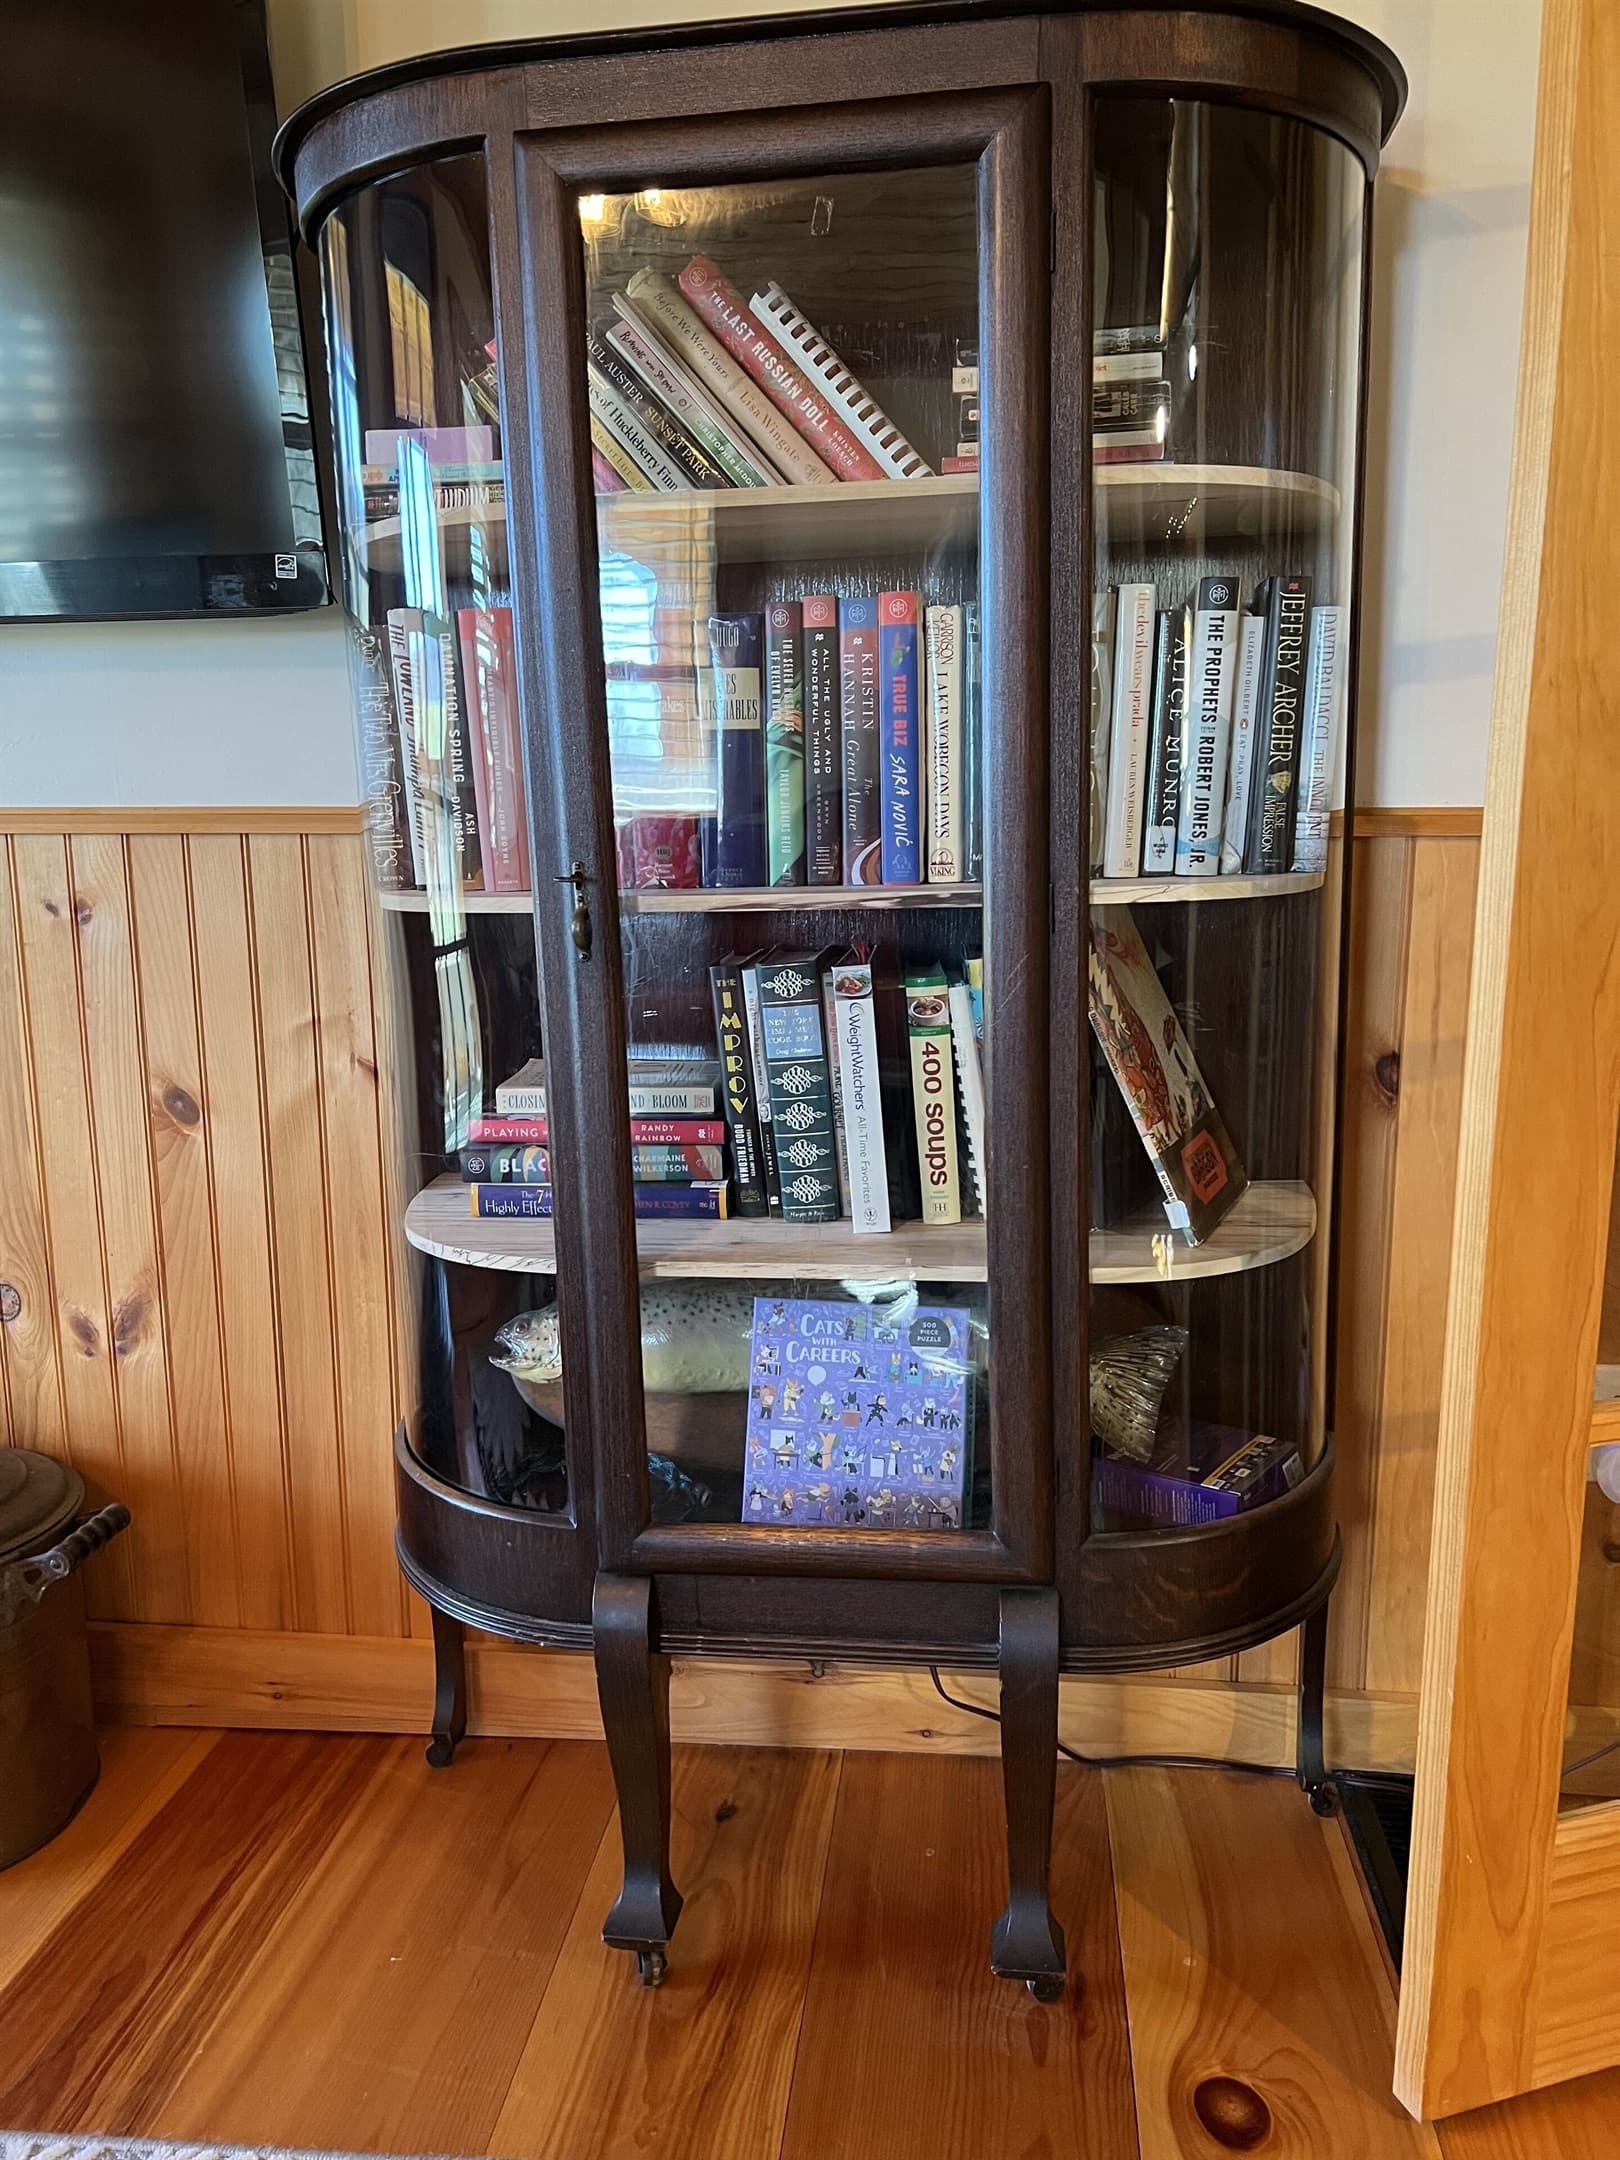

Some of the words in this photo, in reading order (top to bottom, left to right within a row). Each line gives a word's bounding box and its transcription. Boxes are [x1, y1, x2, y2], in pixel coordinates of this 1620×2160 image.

[654, 292, 679, 321] Before
[678, 318, 690, 335] We
[690, 331, 708, 356] Were
[706, 352, 729, 379] Yours
[710, 291, 726, 311] THE
[722, 305, 756, 341] LAST
[751, 340, 802, 400] RUSSIAN
[798, 399, 829, 433] DOLL
[605, 362, 644, 403] AUSTER
[600, 396, 613, 410] of
[610, 407, 660, 469] Huckleberry
[657, 465, 678, 491] Finn
[645, 406, 685, 449] SUNSET
[682, 446, 711, 481] PARK
[739, 391, 759, 418] Lisa
[761, 413, 800, 463] Wingate
[833, 431, 860, 462] KRISTEN
[390, 624, 405, 650] THE
[716, 627, 739, 647] HUGO
[782, 639, 792, 654] THE
[940, 613, 954, 665] GARRISON
[1208, 615, 1225, 641] THE
[1277, 591, 1306, 675] JEFFREY
[1317, 613, 1337, 663] DAVID
[771, 651, 780, 661] OF
[783, 658, 794, 683] SEVEN
[823, 648, 831, 671] ALL
[1245, 630, 1256, 677] ELIZABETH
[440, 633, 459, 721] DAMNATION
[771, 665, 780, 695] EVELYN
[811, 648, 819, 724] WONDERFUL
[823, 679, 831, 702] THE
[843, 654, 856, 730] HANNAH
[861, 653, 874, 730] KRISTIN
[892, 675, 907, 714] TRUE
[937, 672, 949, 715] LAKE
[1169, 638, 1185, 721] ALICE
[1201, 647, 1222, 723] PROPHETS
[1242, 680, 1252, 715] GILBERT
[893, 720, 908, 747] BIZ
[1268, 680, 1298, 766] ARCHER
[449, 729, 467, 783] SPRING
[813, 730, 821, 774] THINGS
[846, 739, 860, 782] Great
[1195, 736, 1215, 792] ROBERT
[780, 769, 790, 796] TAYLOR
[864, 778, 873, 795] The
[890, 753, 910, 796] SARA
[367, 780, 403, 867] Grenvilles
[451, 796, 465, 852] DAVIDSON
[465, 813, 476, 835] ASH
[781, 801, 790, 832] JENKINS
[848, 787, 861, 831] Alone
[891, 801, 914, 848] NOVIĆ
[1189, 796, 1210, 843] JONES,
[1261, 795, 1277, 853] IMPRESSION
[1274, 802, 1287, 829] FALSE
[930, 866, 956, 876] VIKING
[1189, 848, 1206, 868] JR.
[716, 979, 737, 987] THE
[719, 991, 749, 1114] IMPROV
[847, 1014, 866, 1111] WeightWatchers
[922, 1042, 942, 1094] 400
[508, 1094, 546, 1109] CLOSIN
[652, 1094, 687, 1109] BLOOM
[484, 1127, 538, 1137] PLAYING
[635, 1134, 681, 1142] RAINBOW
[641, 1124, 675, 1132] RANDY
[734, 1124, 745, 1144] BUDD
[857, 1116, 868, 1158] All-Time
[925, 1103, 948, 1186] soups
[500, 1158, 546, 1174] BLAC
[632, 1164, 688, 1173] WILKERSON
[633, 1153, 686, 1163] CHARMAINE
[736, 1146, 750, 1184] FRIEDMAN
[521, 1190, 534, 1199] The
[536, 1189, 544, 1204] 7
[860, 1161, 871, 1204] Favorites
[485, 1199, 520, 1216] Highly
[522, 1200, 552, 1214] Effect
[785, 1341, 861, 1365] CAREERS
[812, 1337, 838, 1347] WITH
